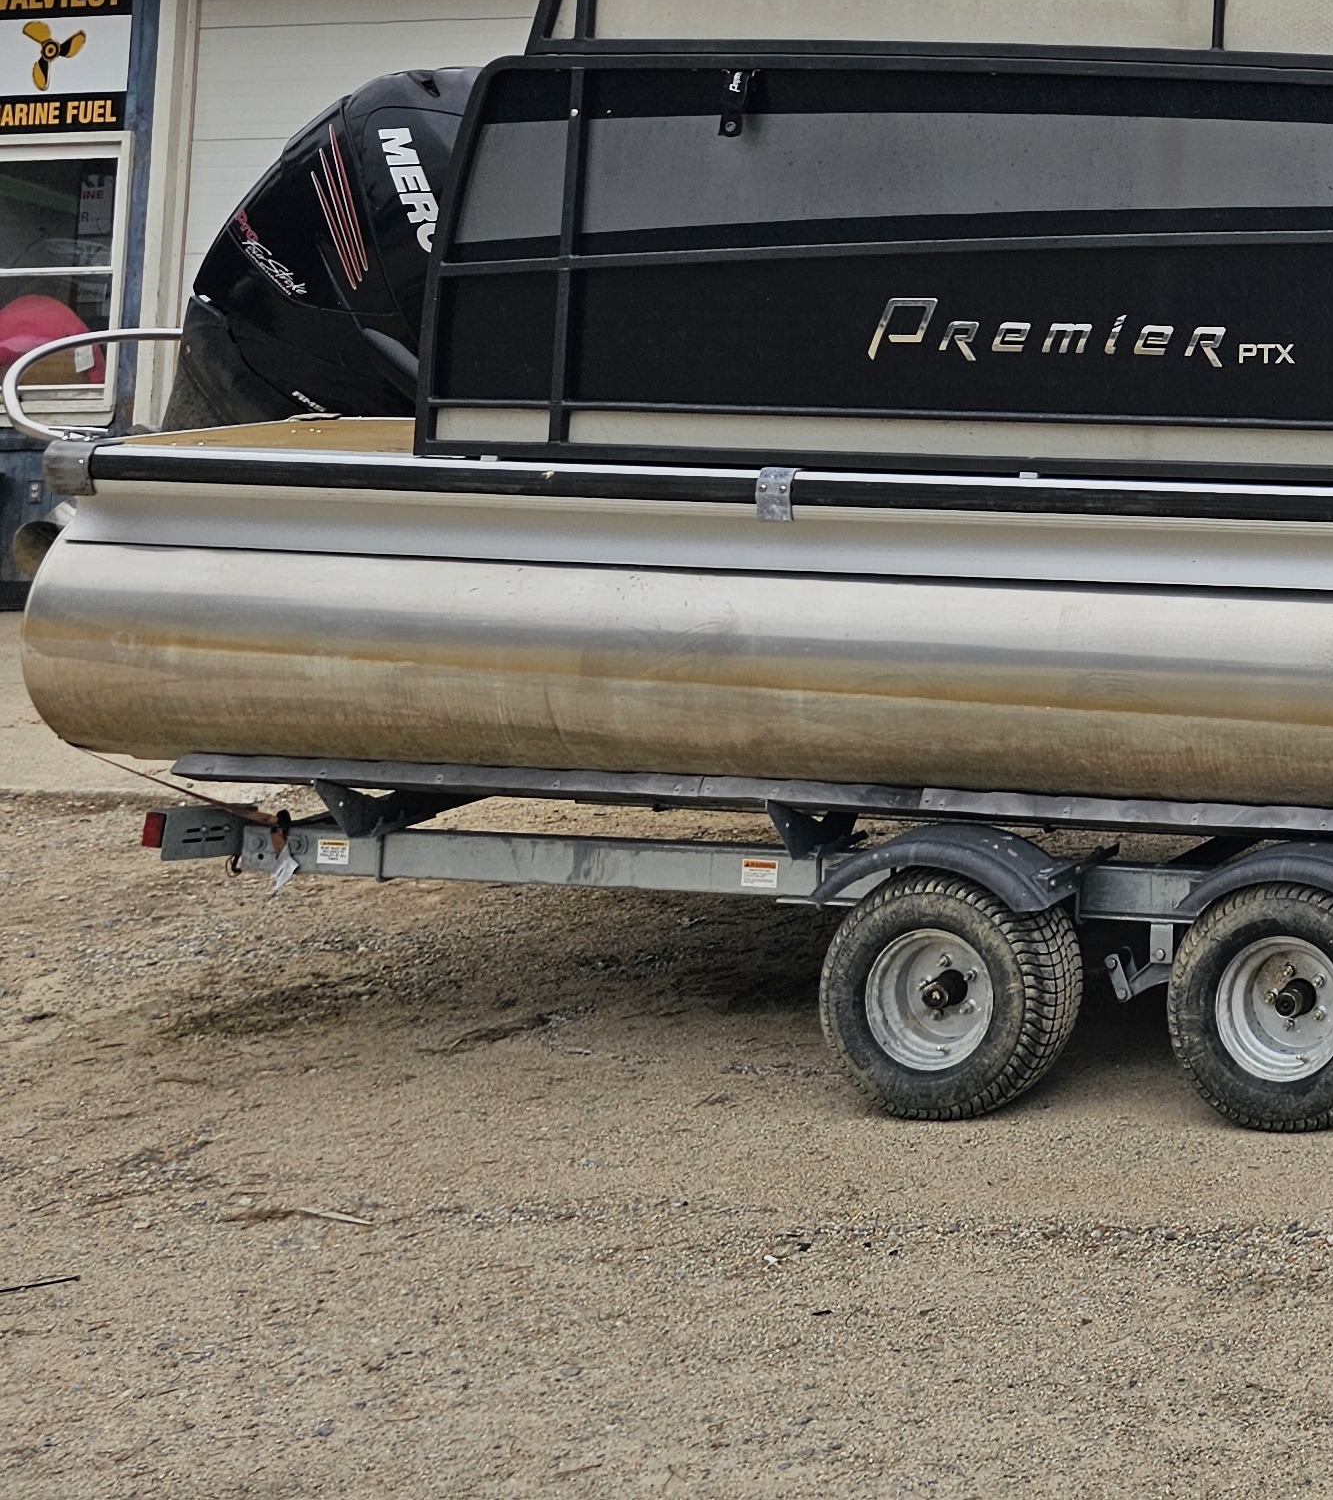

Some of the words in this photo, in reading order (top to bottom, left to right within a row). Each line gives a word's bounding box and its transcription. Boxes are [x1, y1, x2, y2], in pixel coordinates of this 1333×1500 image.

[0, 102, 60, 126] ARINE
[66, 100, 117, 124] FUEL
[1238, 343, 1296, 364] PTX
